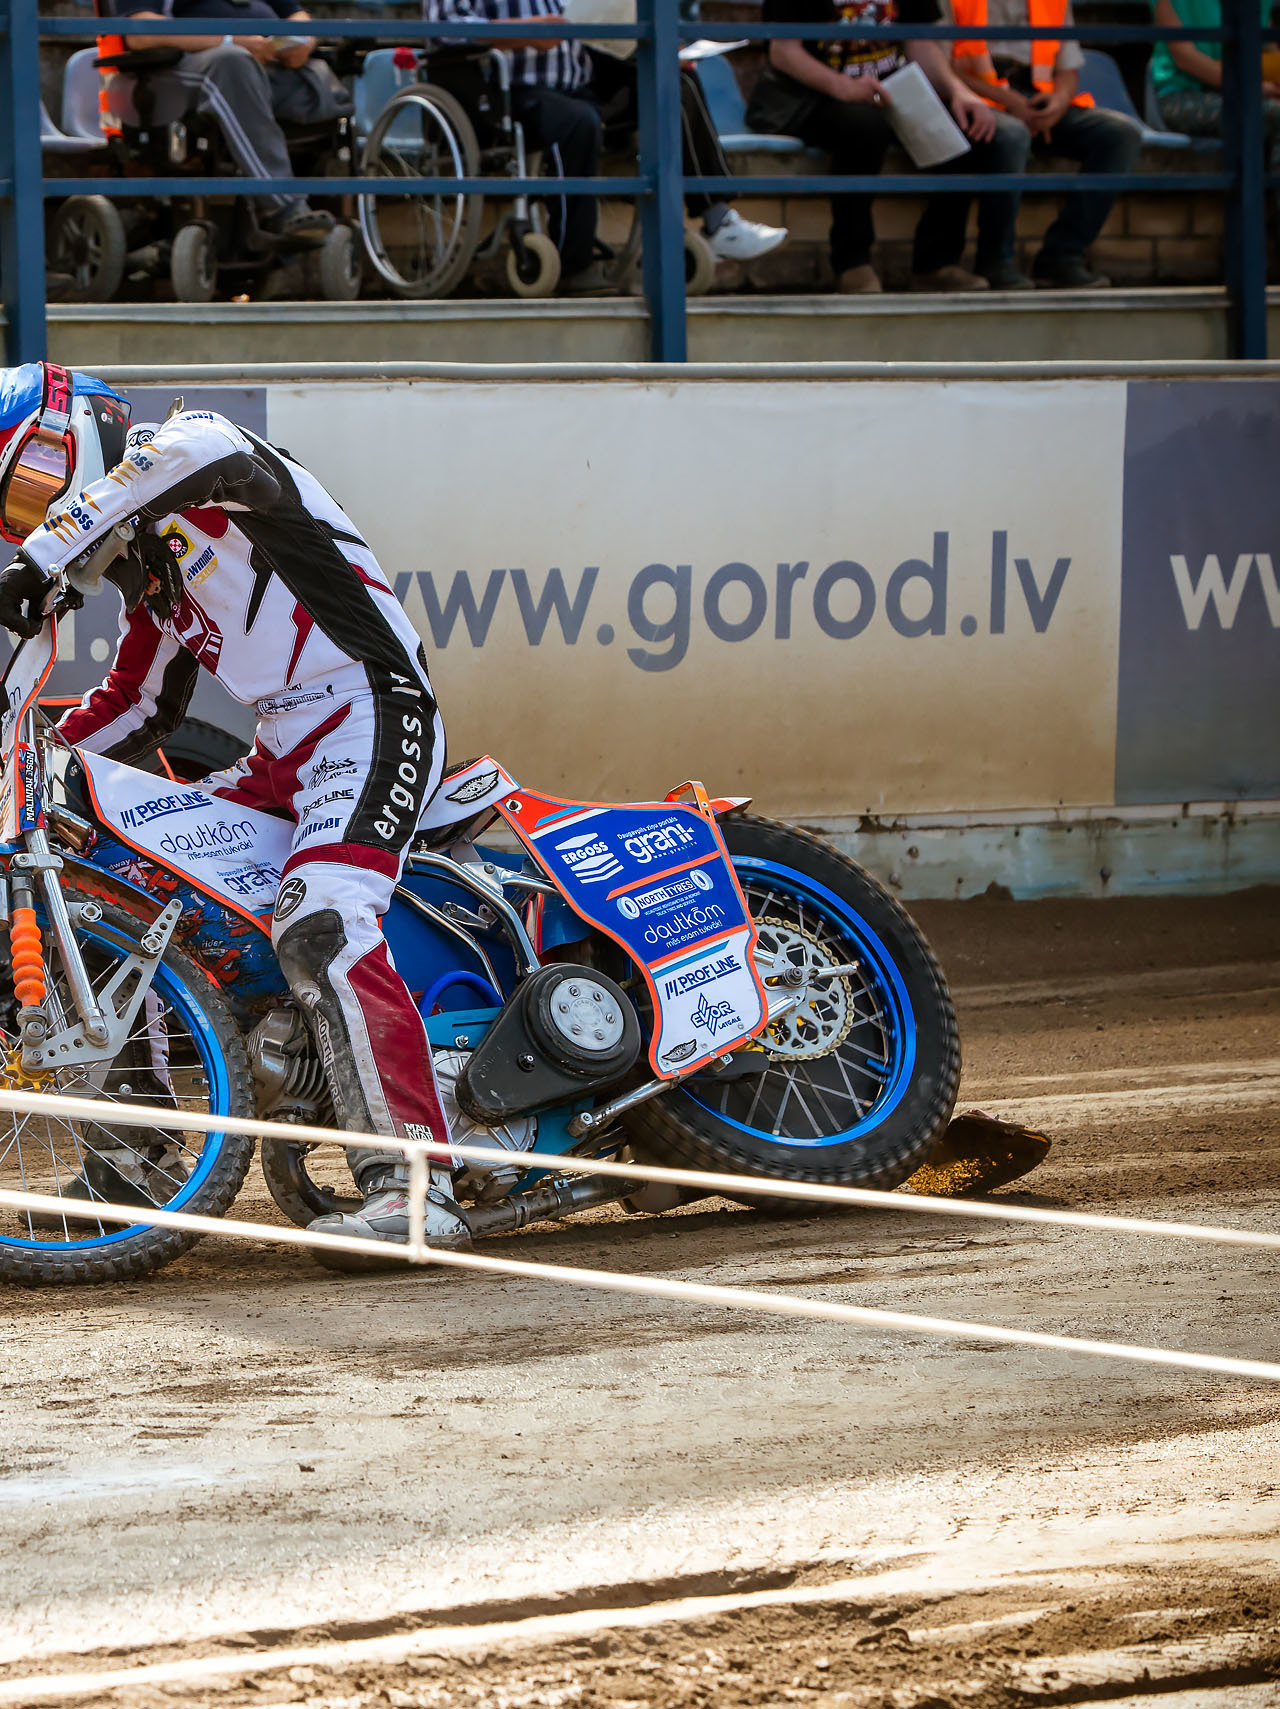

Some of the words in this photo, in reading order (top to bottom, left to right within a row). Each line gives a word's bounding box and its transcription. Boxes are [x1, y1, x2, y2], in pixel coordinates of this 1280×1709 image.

[394, 530, 1072, 673] ww.gorod.lv
[561, 841, 609, 865] ERGOSS
[637, 888, 666, 908] NORTH
[665, 880, 694, 897] TYRES
[718, 1015, 742, 1029] LATGALE
